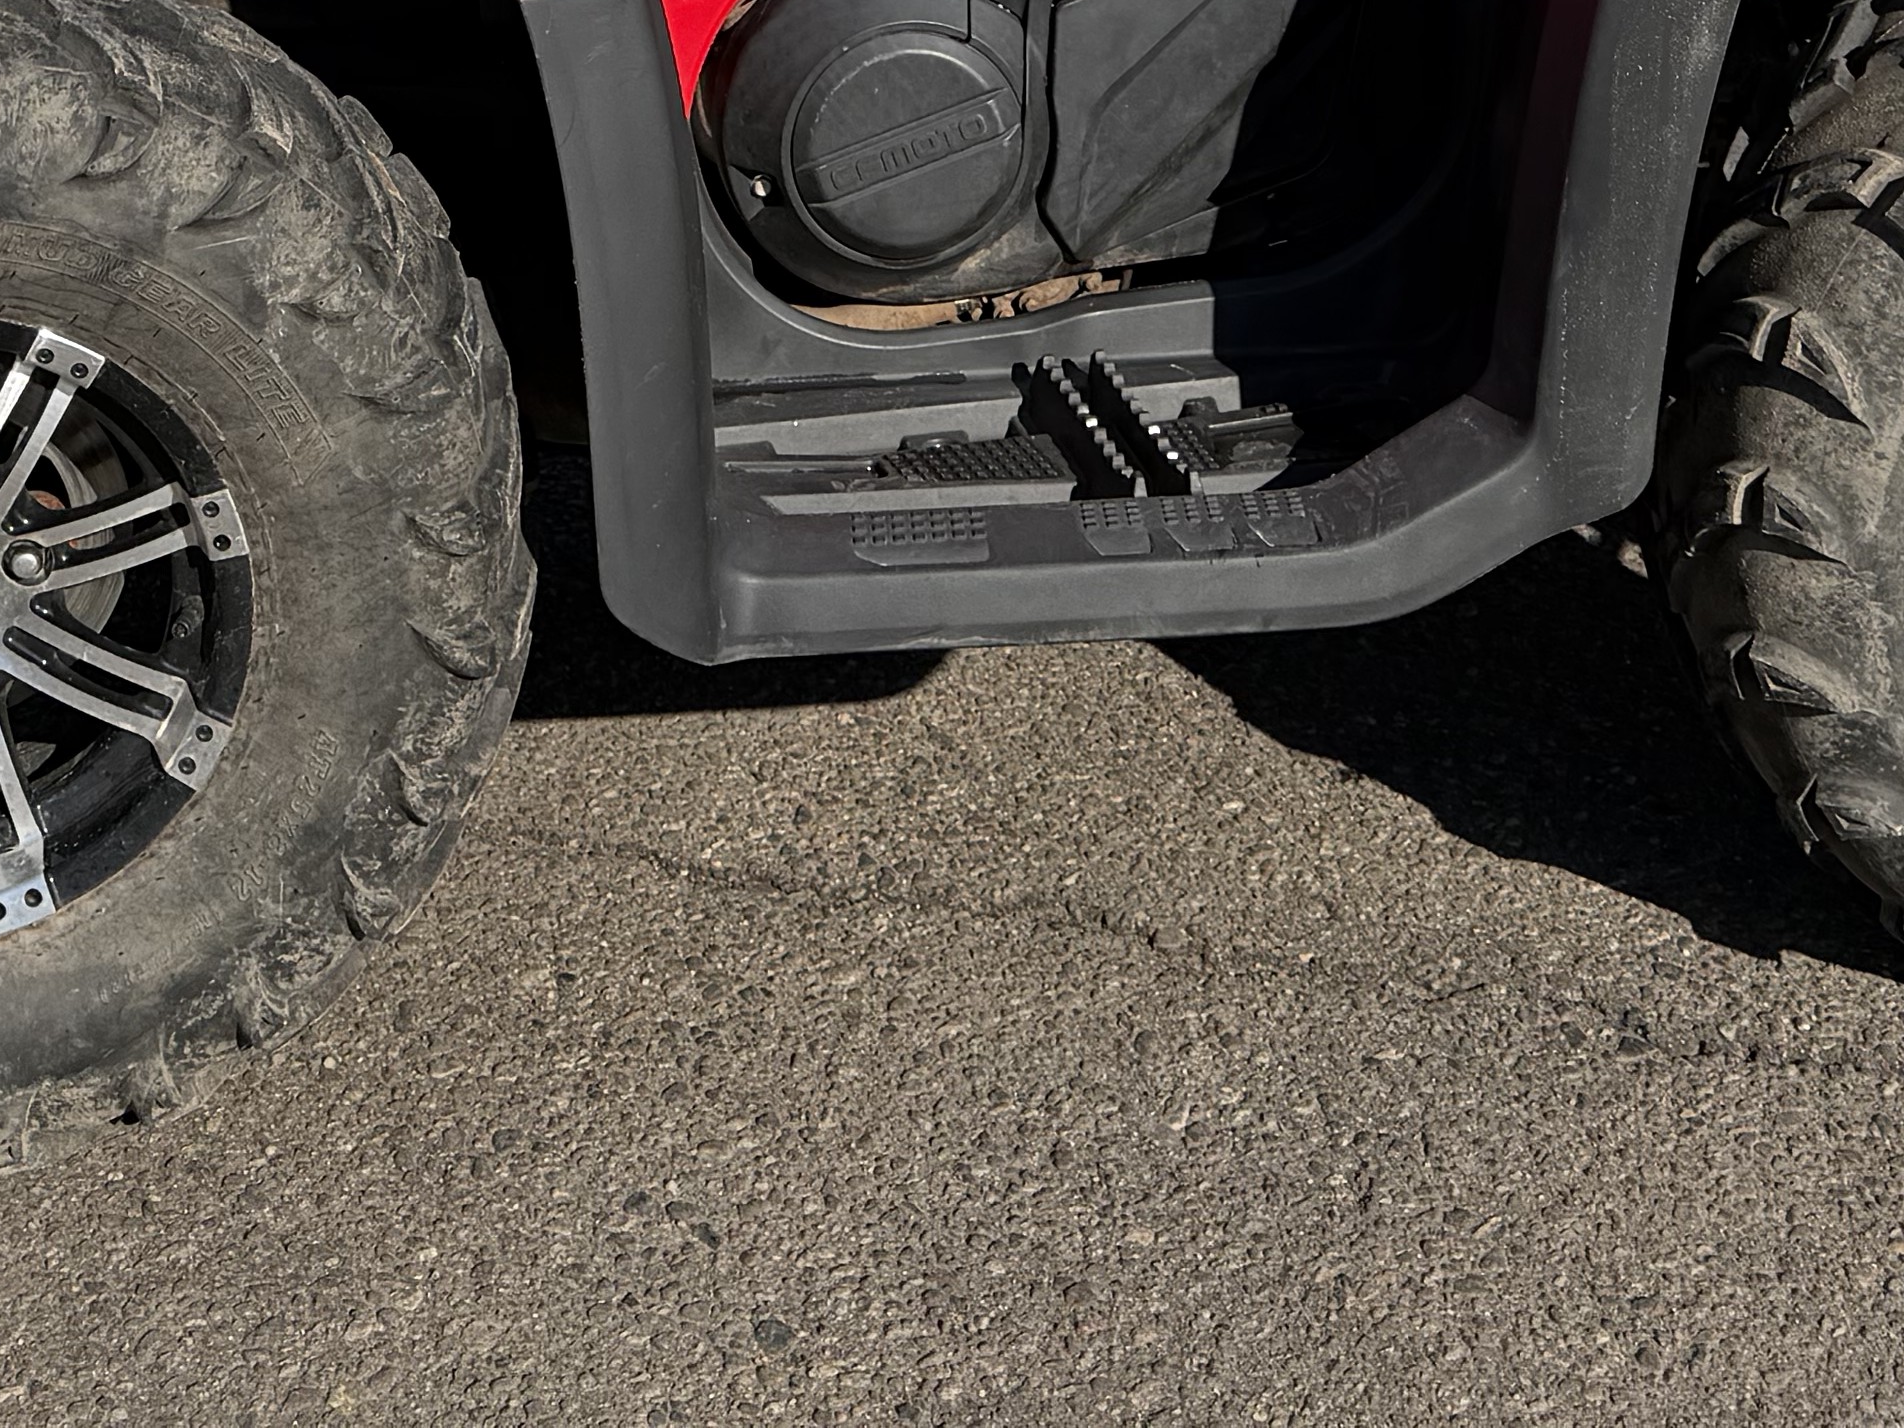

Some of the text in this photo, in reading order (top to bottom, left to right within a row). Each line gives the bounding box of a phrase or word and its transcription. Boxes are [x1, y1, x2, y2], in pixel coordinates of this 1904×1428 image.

[4, 229, 307, 429] MUD GEAR LITE
